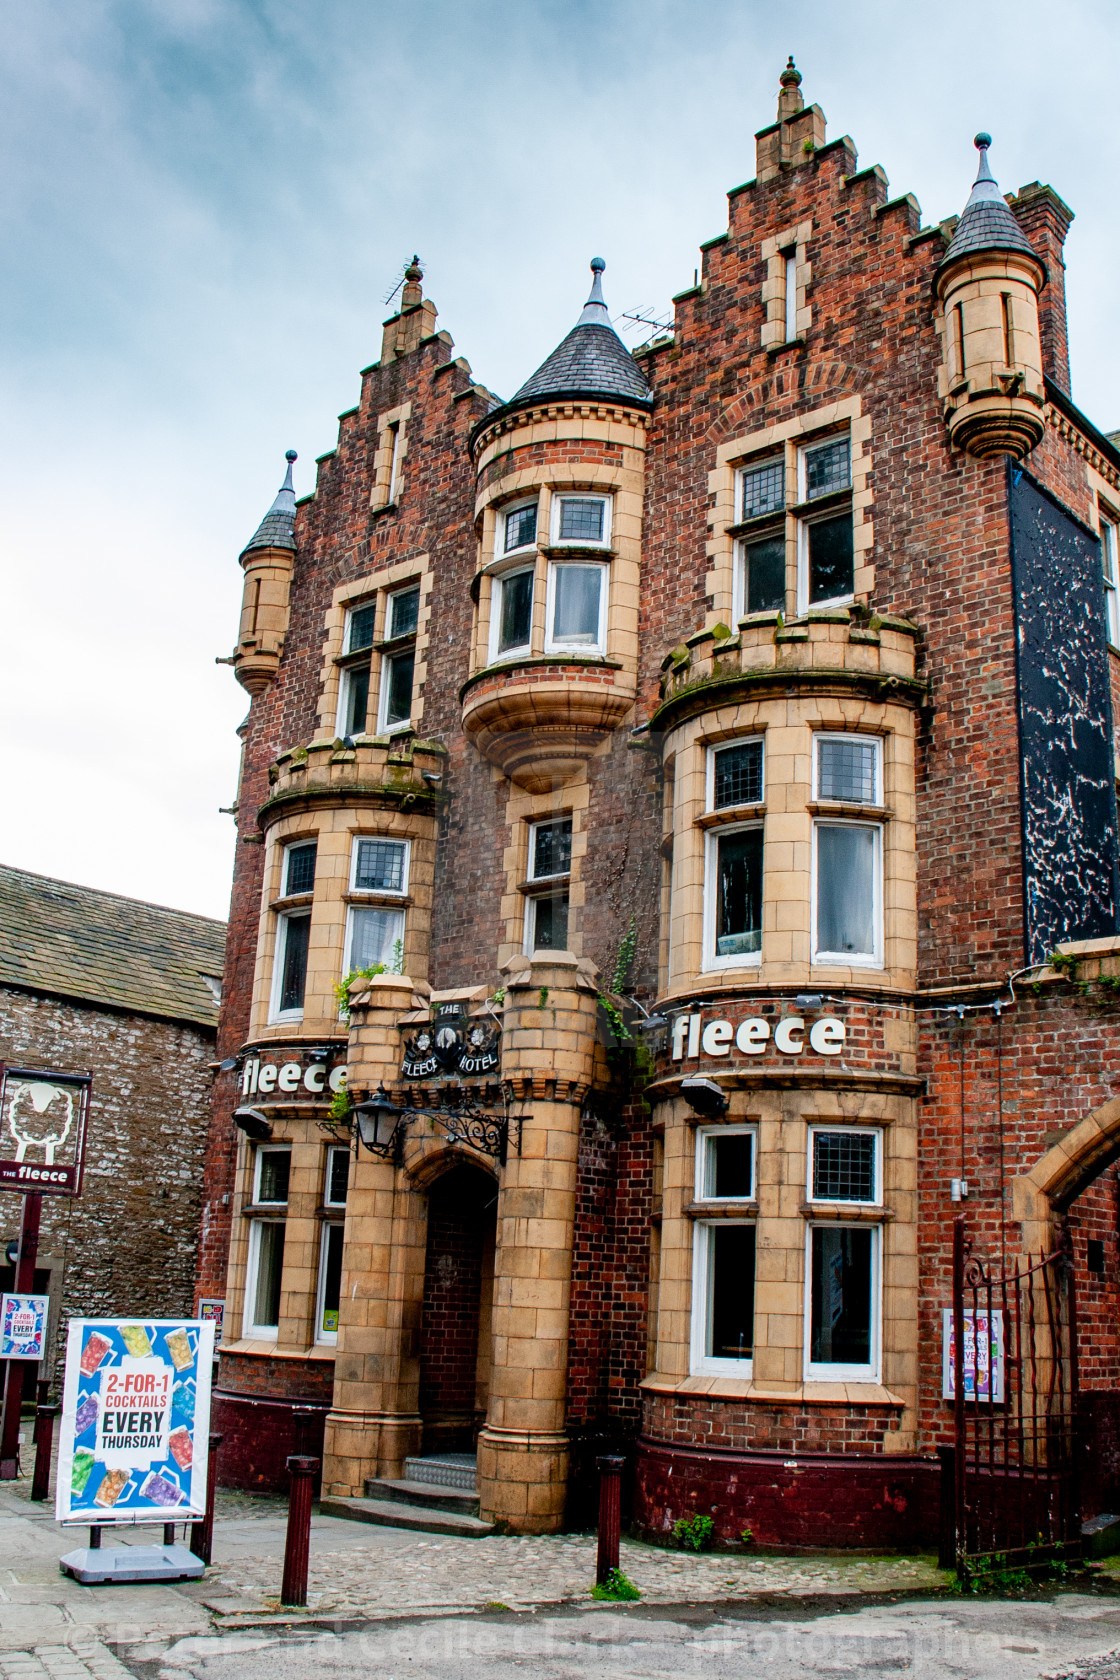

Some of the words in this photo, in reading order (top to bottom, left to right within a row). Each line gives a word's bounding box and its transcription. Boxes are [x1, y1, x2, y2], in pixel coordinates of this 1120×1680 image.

[439, 1003, 460, 1016] THE
[672, 1013, 847, 1061] fleece
[401, 1056, 438, 1077] FLEECE
[458, 1053, 498, 1072] HOTEL
[242, 1058, 348, 1096] fleece
[3, 1170, 16, 1178] THE
[18, 1165, 68, 1183] fleece
[964, 1351, 987, 1360] VERY
[106, 1373, 169, 1393] 2-FOR-1
[105, 1395, 167, 1408] COCKTAILS
[102, 1411, 164, 1433] EVERY
[102, 1434, 162, 1449] THURSDAY
